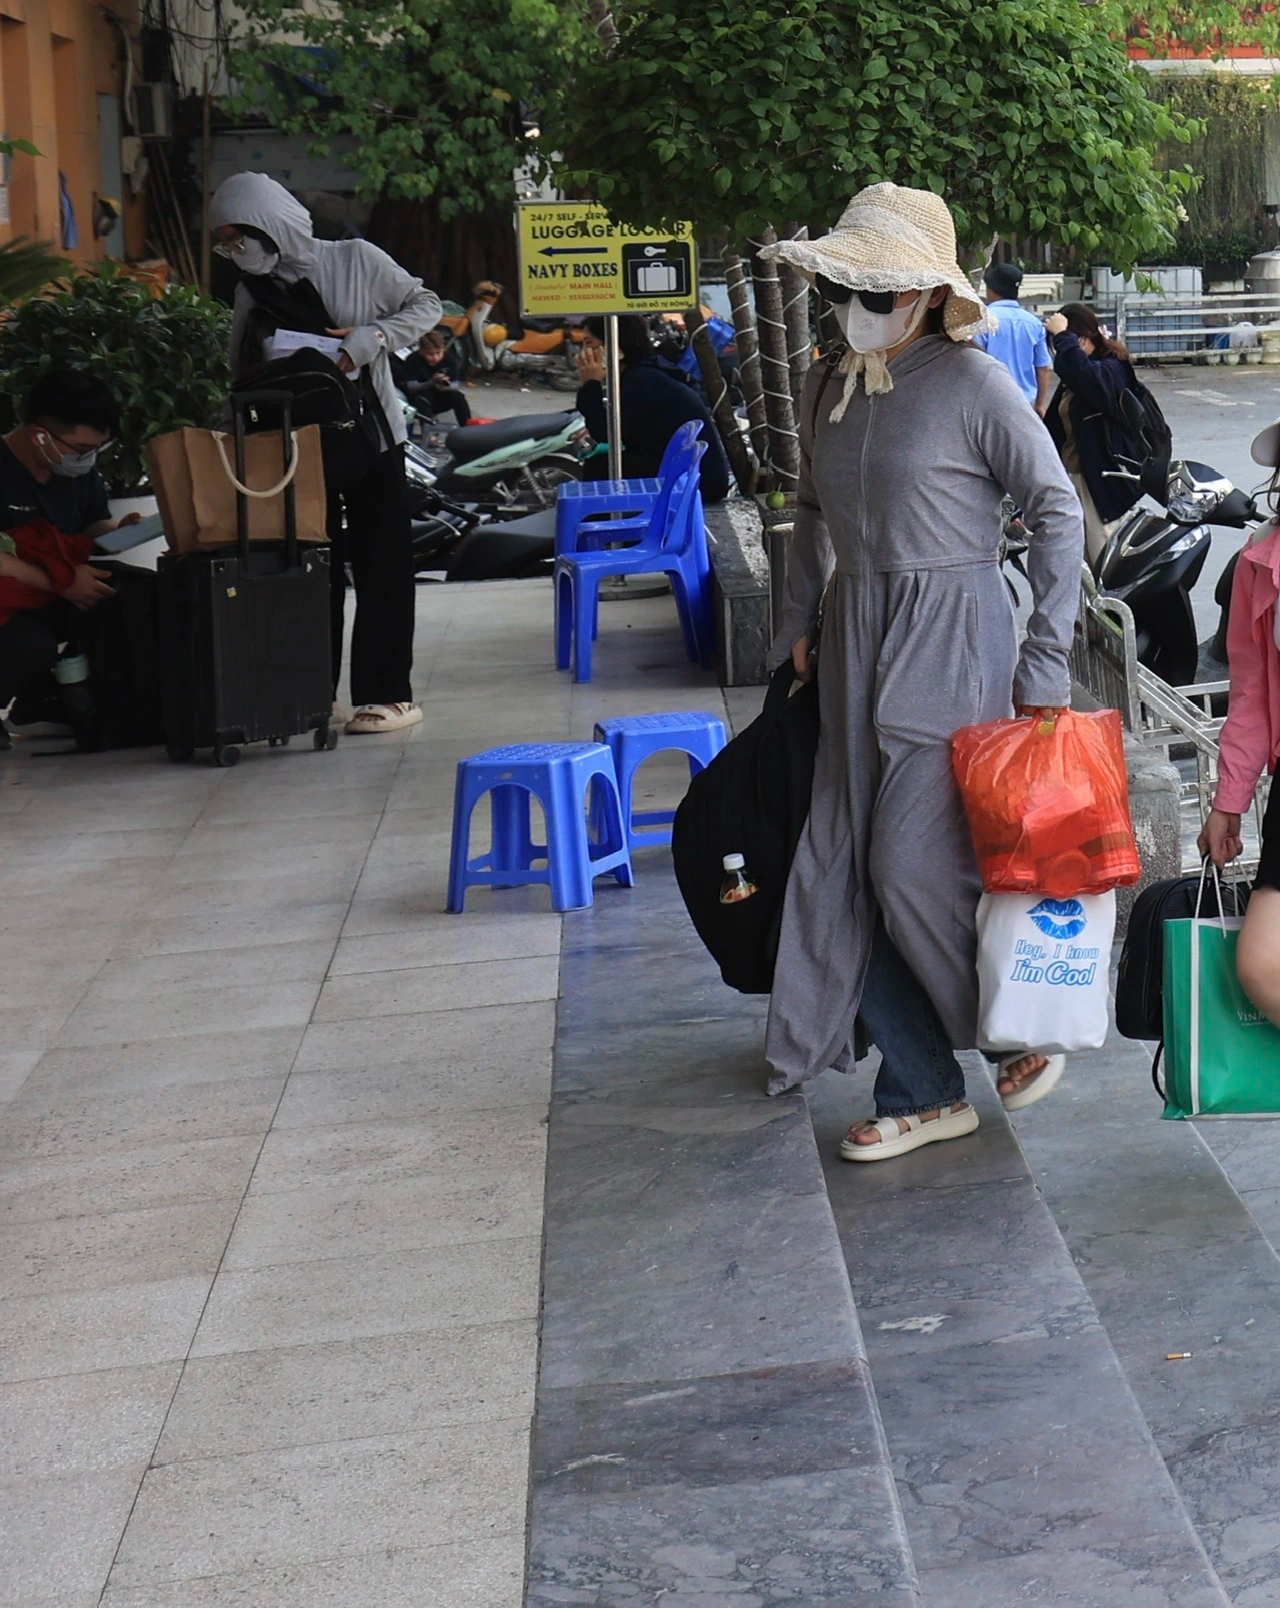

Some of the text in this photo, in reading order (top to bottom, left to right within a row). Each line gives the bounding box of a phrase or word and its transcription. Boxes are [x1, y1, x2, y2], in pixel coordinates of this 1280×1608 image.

[530, 213, 553, 222] 24/7
[556, 212, 576, 221] SELF
[531, 221, 686, 239] LUGGAGE LOCKR
[528, 262, 618, 279] NAVY BOXES
[569, 282, 591, 290] MAIN
[593, 281, 613, 289] HALL
[1015, 939, 1100, 960] Hey, I know
[1010, 958, 1097, 986] I'm Cool
